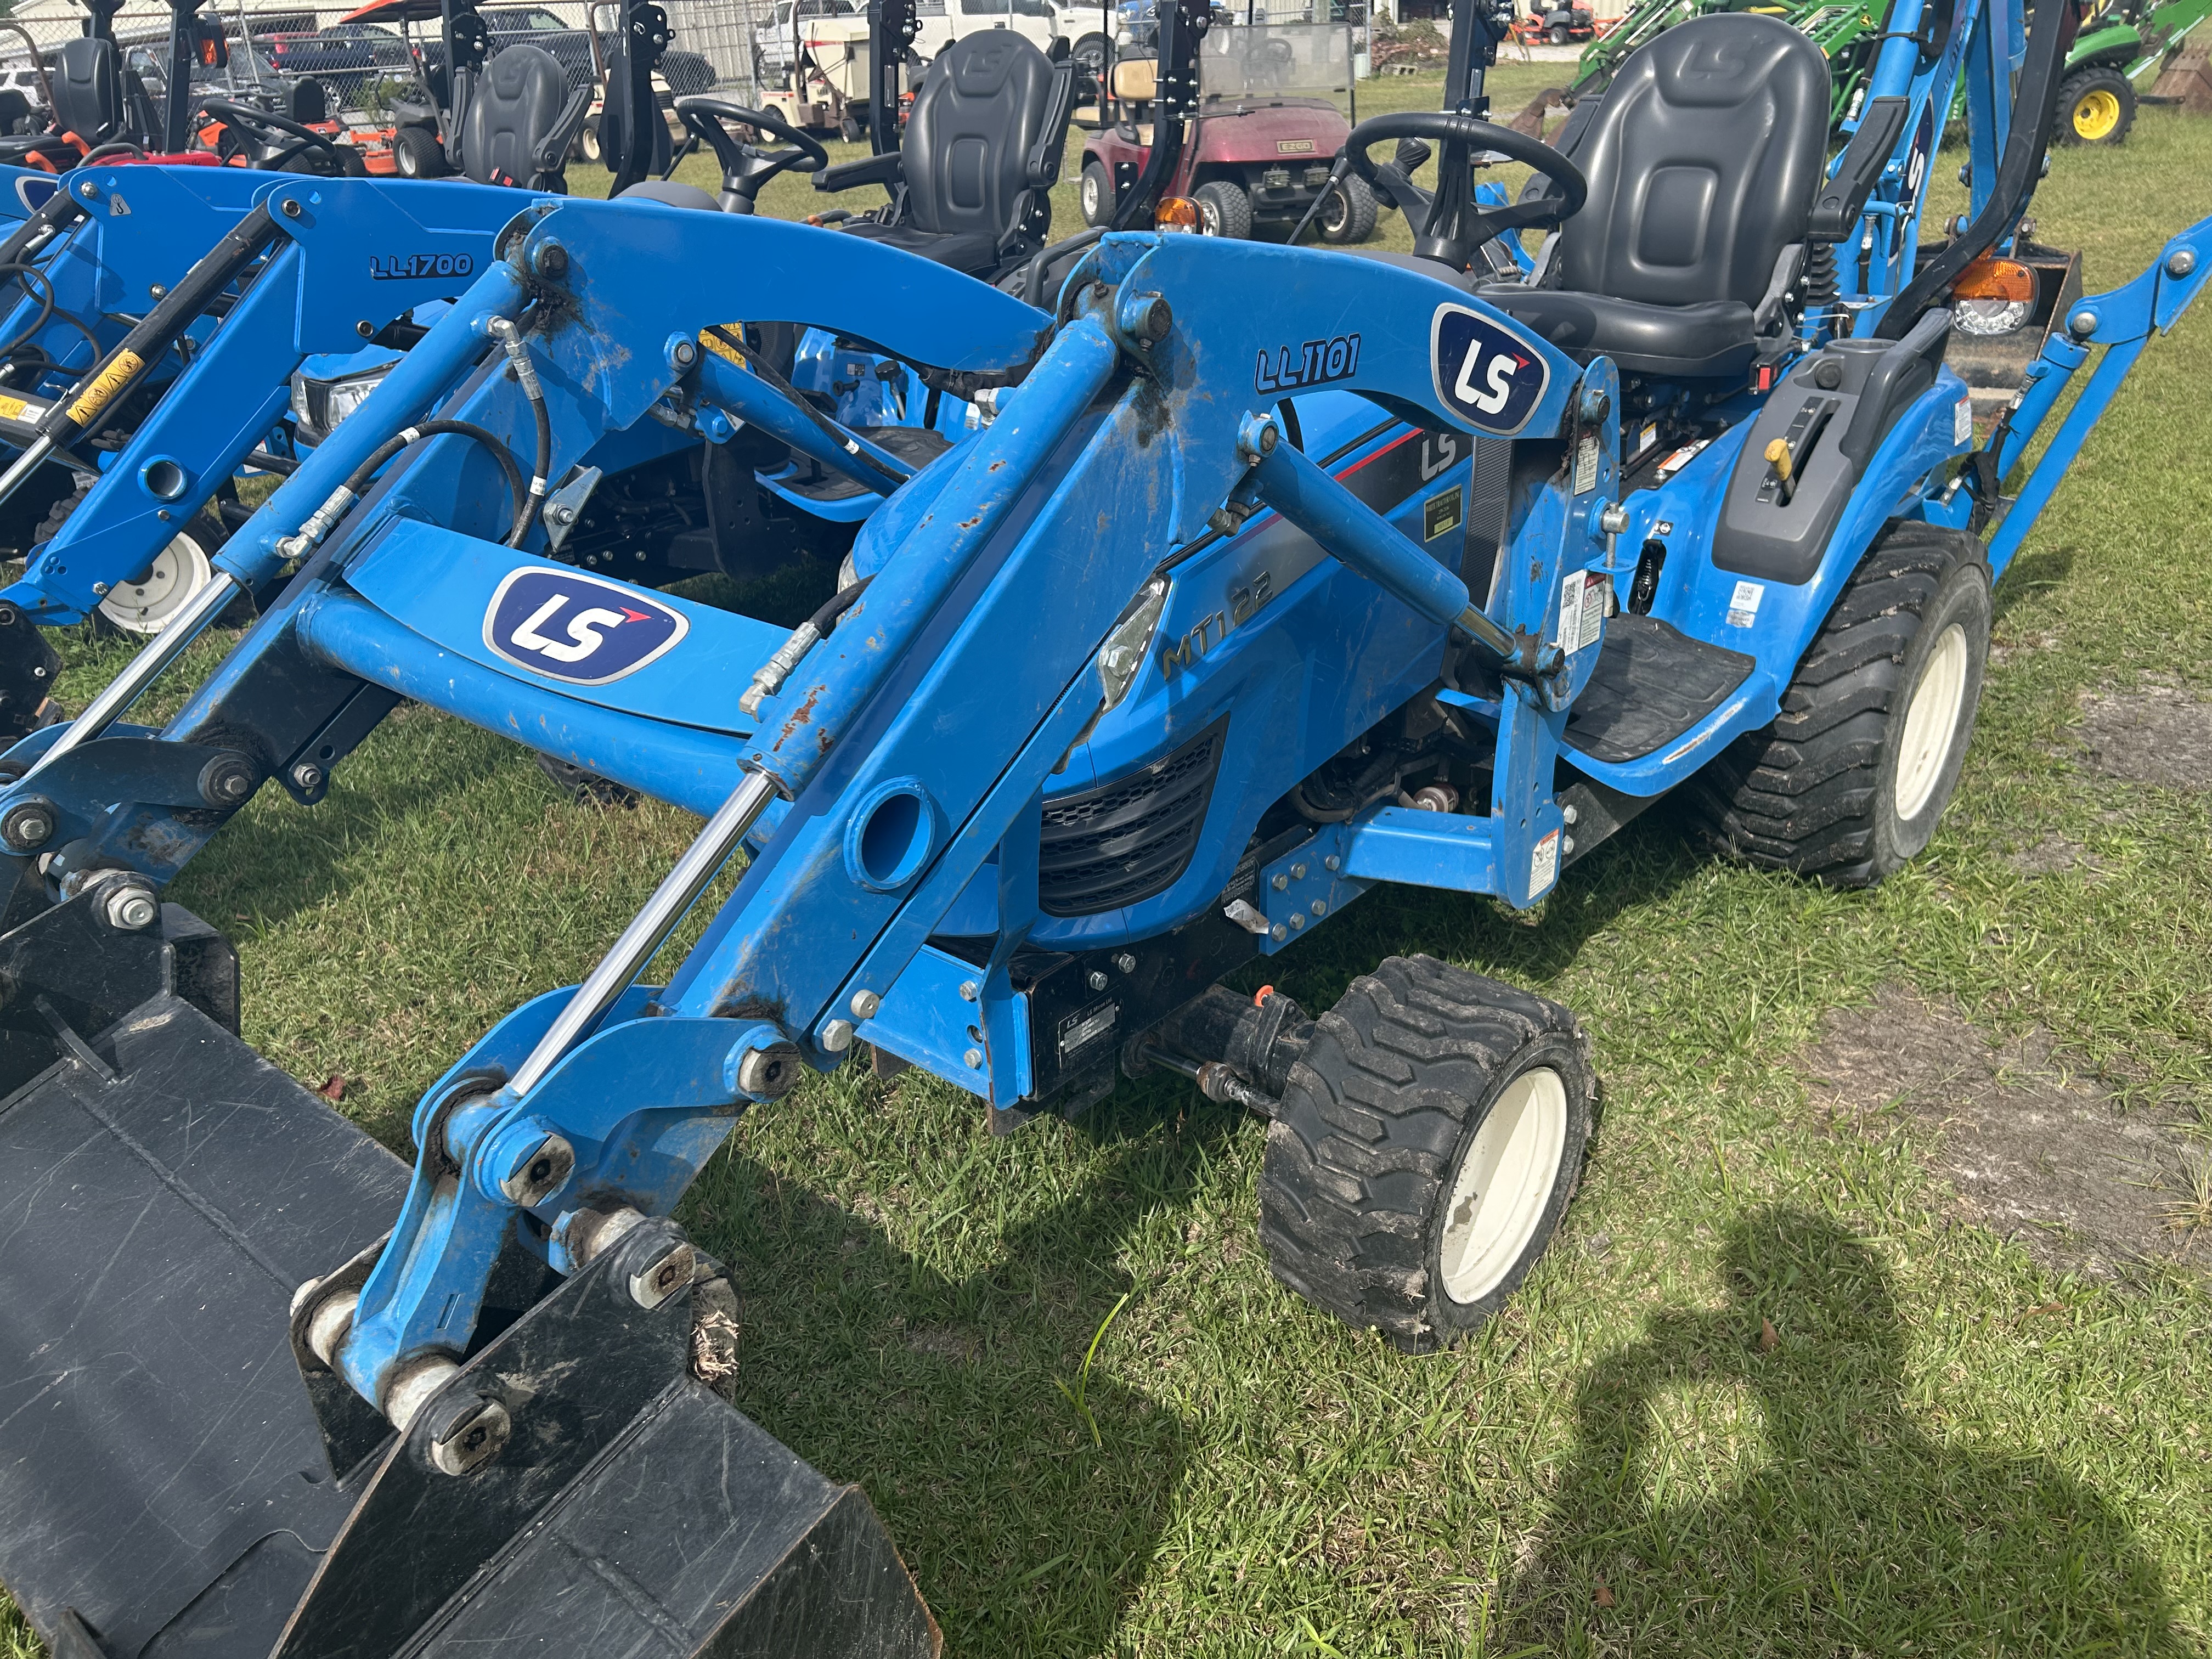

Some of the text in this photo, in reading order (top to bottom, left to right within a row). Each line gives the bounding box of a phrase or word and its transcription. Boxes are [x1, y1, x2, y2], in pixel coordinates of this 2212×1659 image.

[370, 253, 473, 280] LL1700
[1255, 332, 1361, 396] LL1101
[1455, 338, 1517, 414] LS
[1421, 433, 1456, 481] LS
[511, 594, 626, 662] LS
[1066, 1014, 1079, 1029] LS
